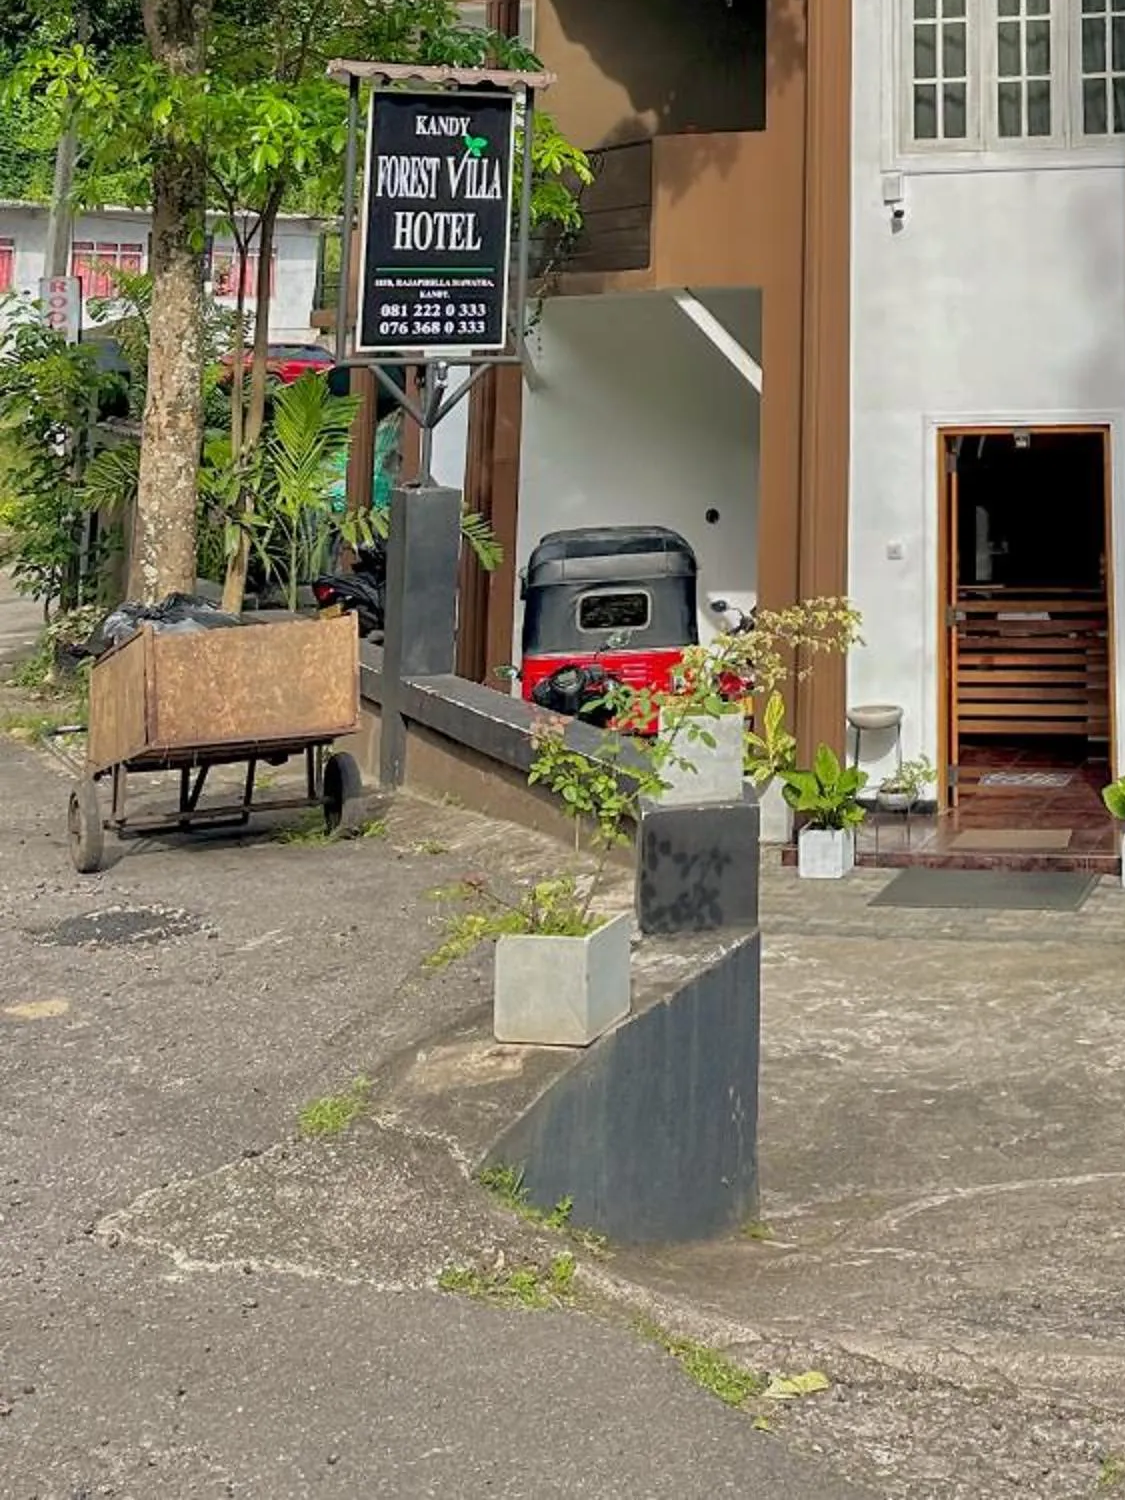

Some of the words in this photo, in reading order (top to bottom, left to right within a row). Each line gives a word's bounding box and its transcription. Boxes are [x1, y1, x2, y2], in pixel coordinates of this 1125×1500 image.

[415, 115, 471, 136] KANDY
[375, 155, 441, 199] FOREST
[446, 150, 503, 199] VILLA
[392, 211, 483, 250] HOTEL
[380, 303, 408, 317] 081
[413, 303, 441, 317] 222
[445, 303, 455, 316] 0
[458, 303, 487, 317] 333
[379, 321, 408, 335] 076
[411, 321, 441, 335] 368
[443, 321, 454, 334] 0
[457, 321, 486, 334] 333
